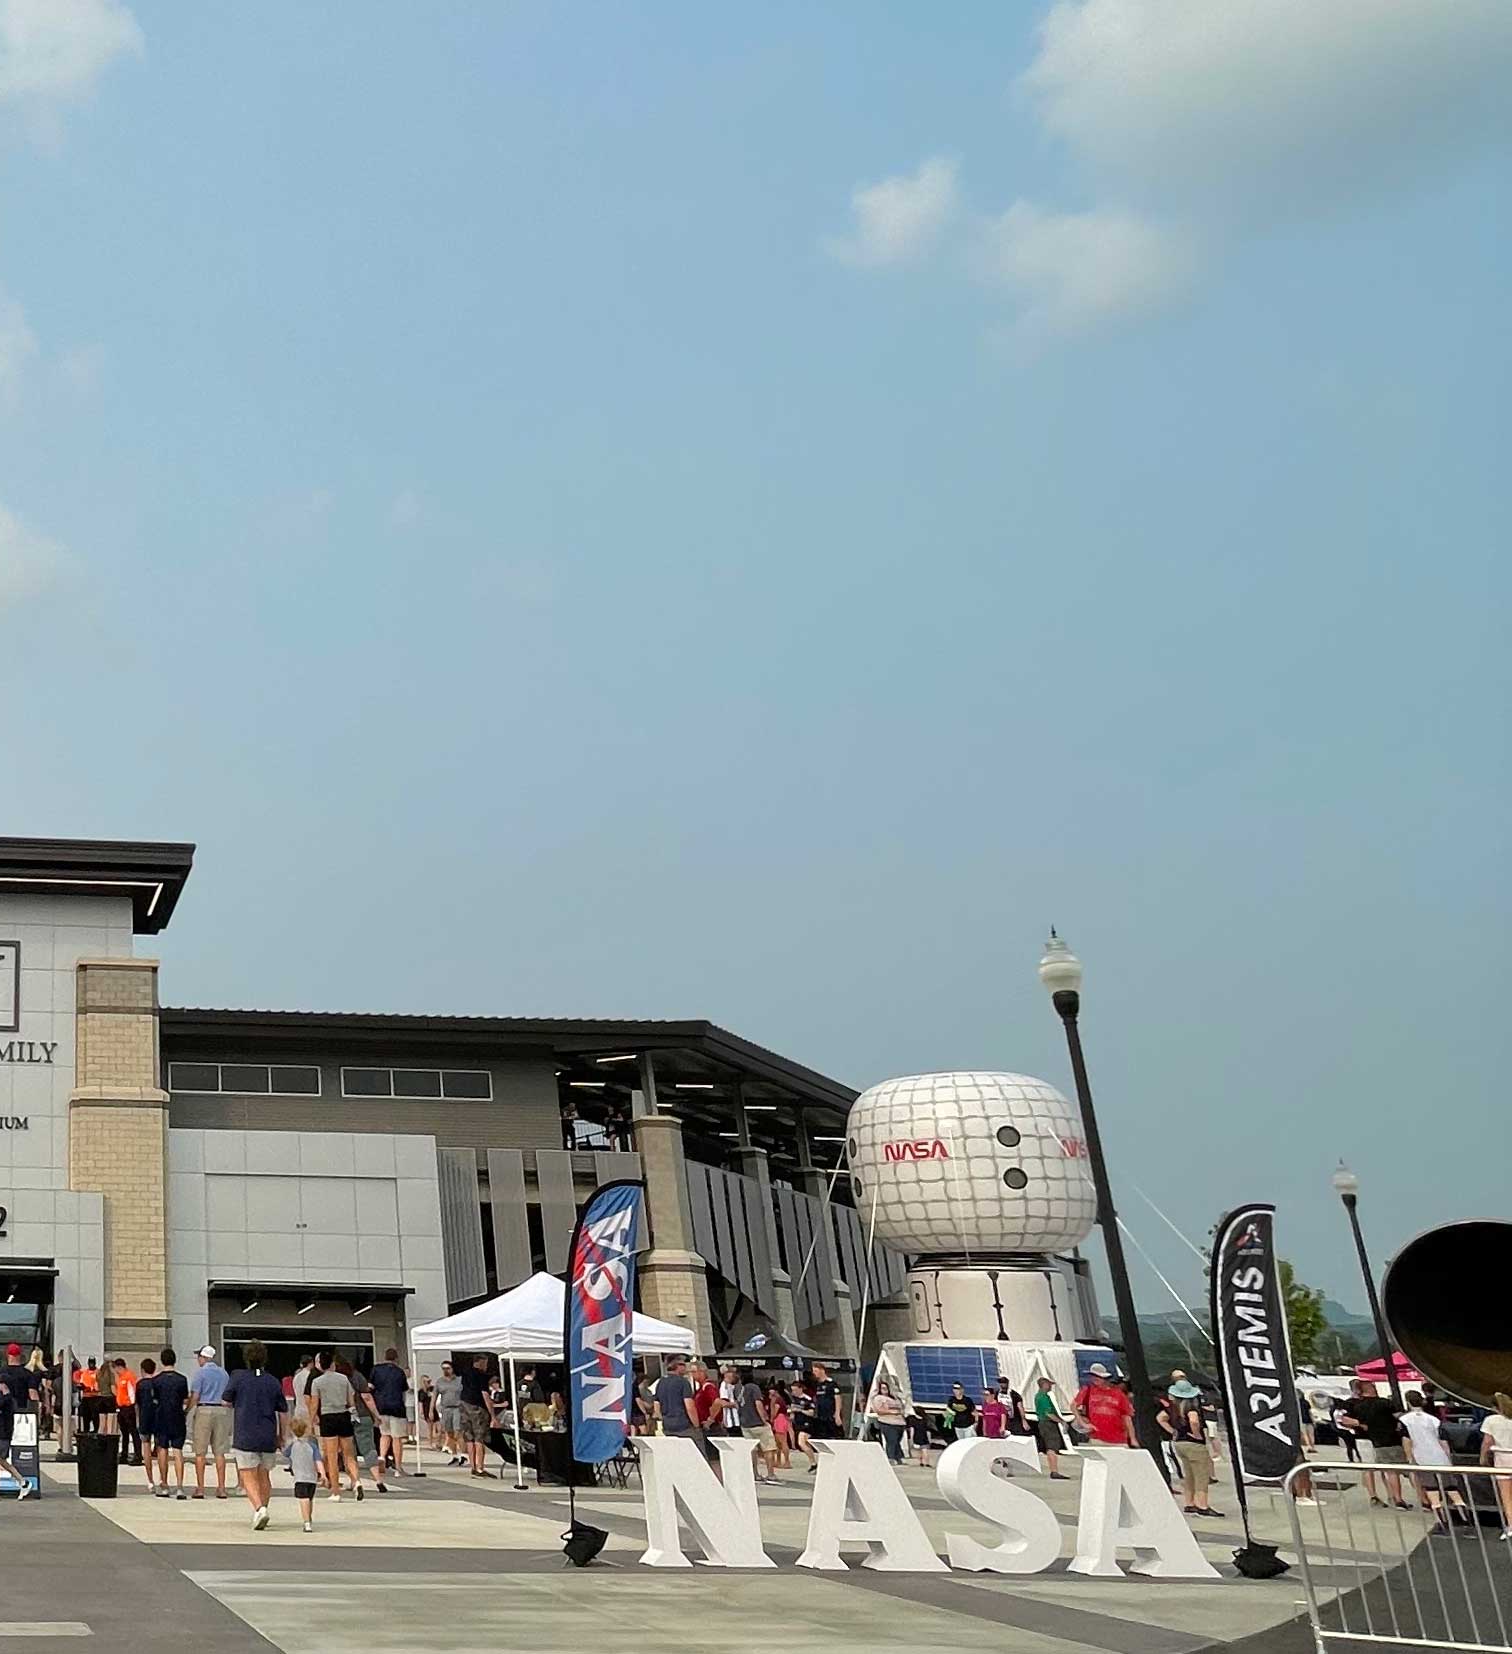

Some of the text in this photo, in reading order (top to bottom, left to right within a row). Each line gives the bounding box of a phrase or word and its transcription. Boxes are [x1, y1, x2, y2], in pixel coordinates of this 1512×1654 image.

[884, 1138, 949, 1161] NASA
[581, 1204, 633, 1424] NASA
[1231, 1266, 1294, 1446] ARTEMIS
[630, 1435, 1223, 1578] NASA
